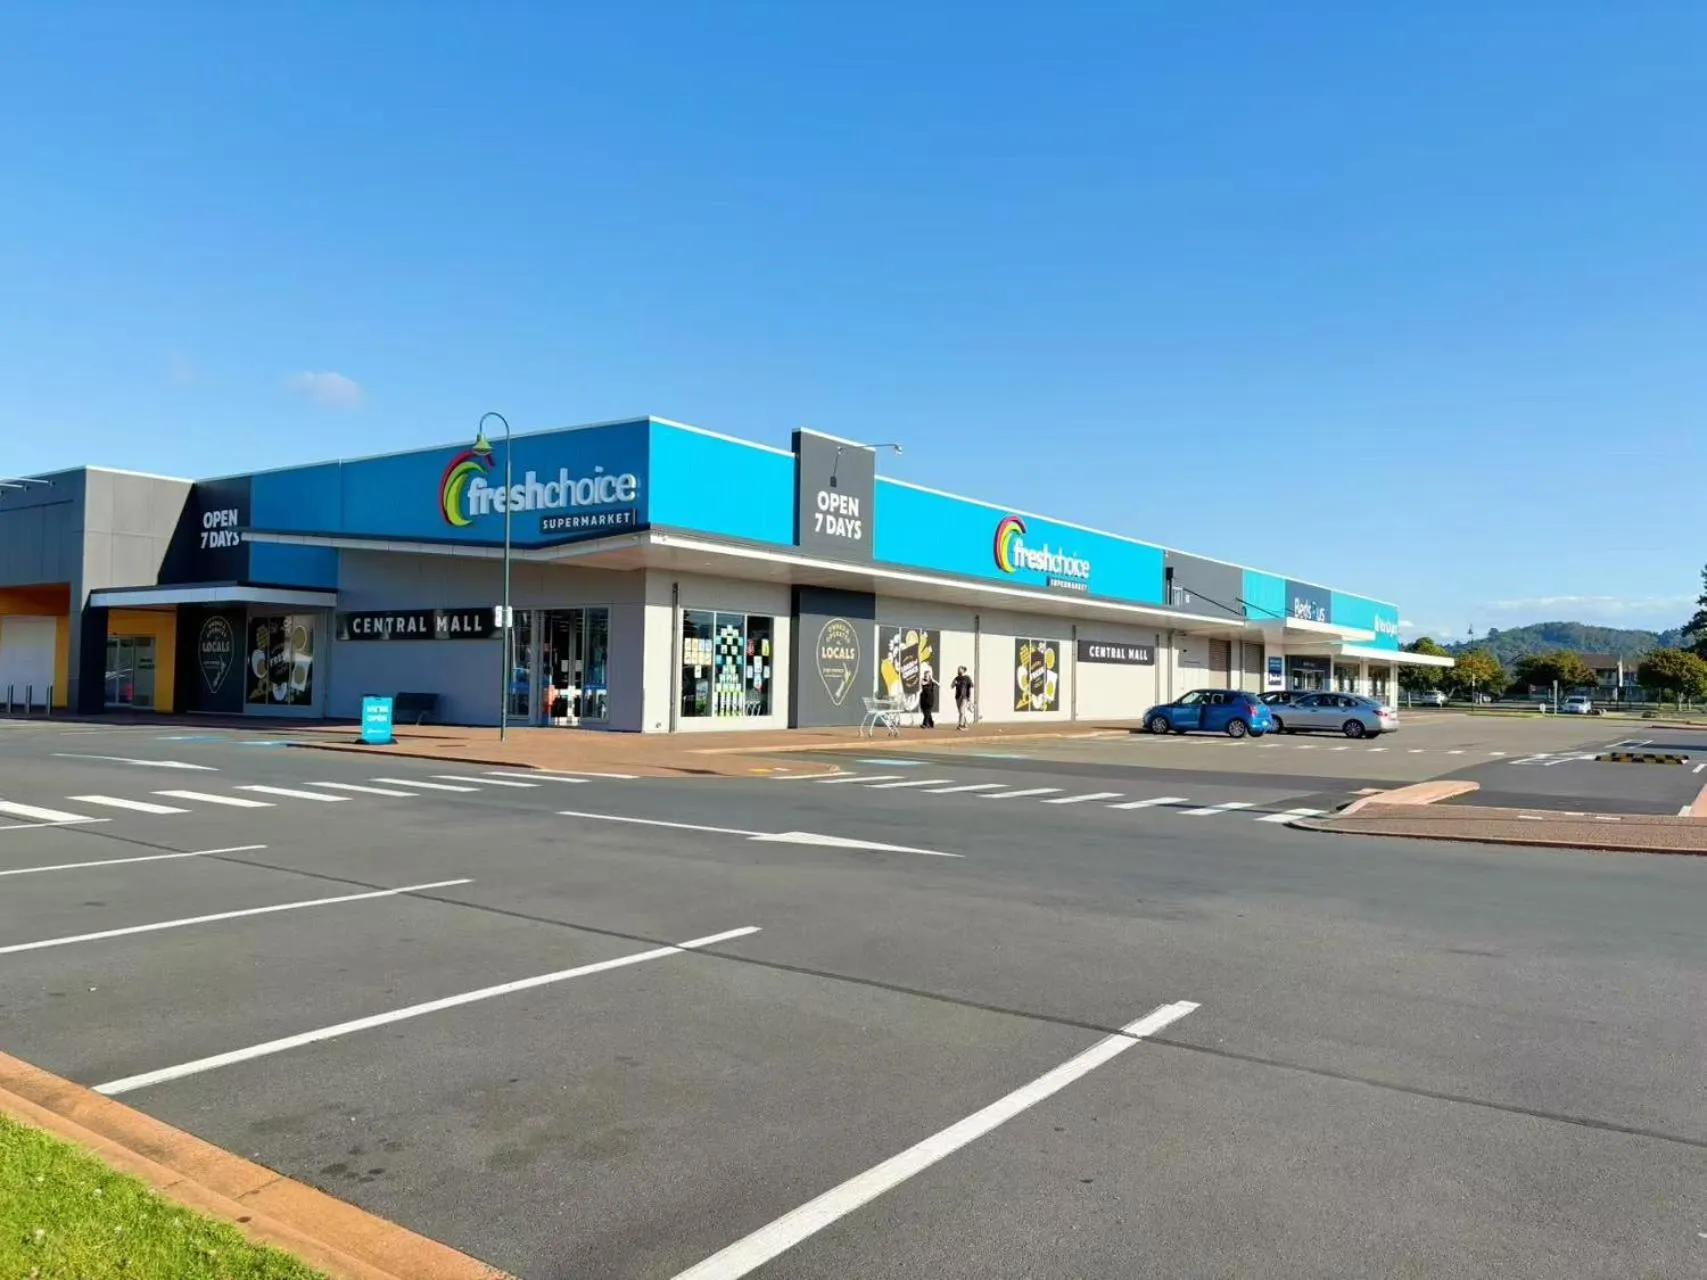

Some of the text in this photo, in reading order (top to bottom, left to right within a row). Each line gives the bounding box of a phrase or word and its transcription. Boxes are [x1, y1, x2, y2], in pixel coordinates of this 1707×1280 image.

[467, 465, 637, 516] freshchoice
[817, 490, 860, 517] OPEN
[203, 508, 238, 528] OPEN
[543, 511, 631, 530] SUPERMARKET
[815, 512, 862, 540] 7 DAYS
[200, 530, 240, 549] 7 DAYS
[1013, 537, 1091, 579] freshchoice
[353, 614, 482, 634] CENTRAL MALL
[202, 641, 230, 652] LOCALS
[821, 646, 855, 659] LOCALS
[1089, 645, 1148, 660] CENTRAL MALL
